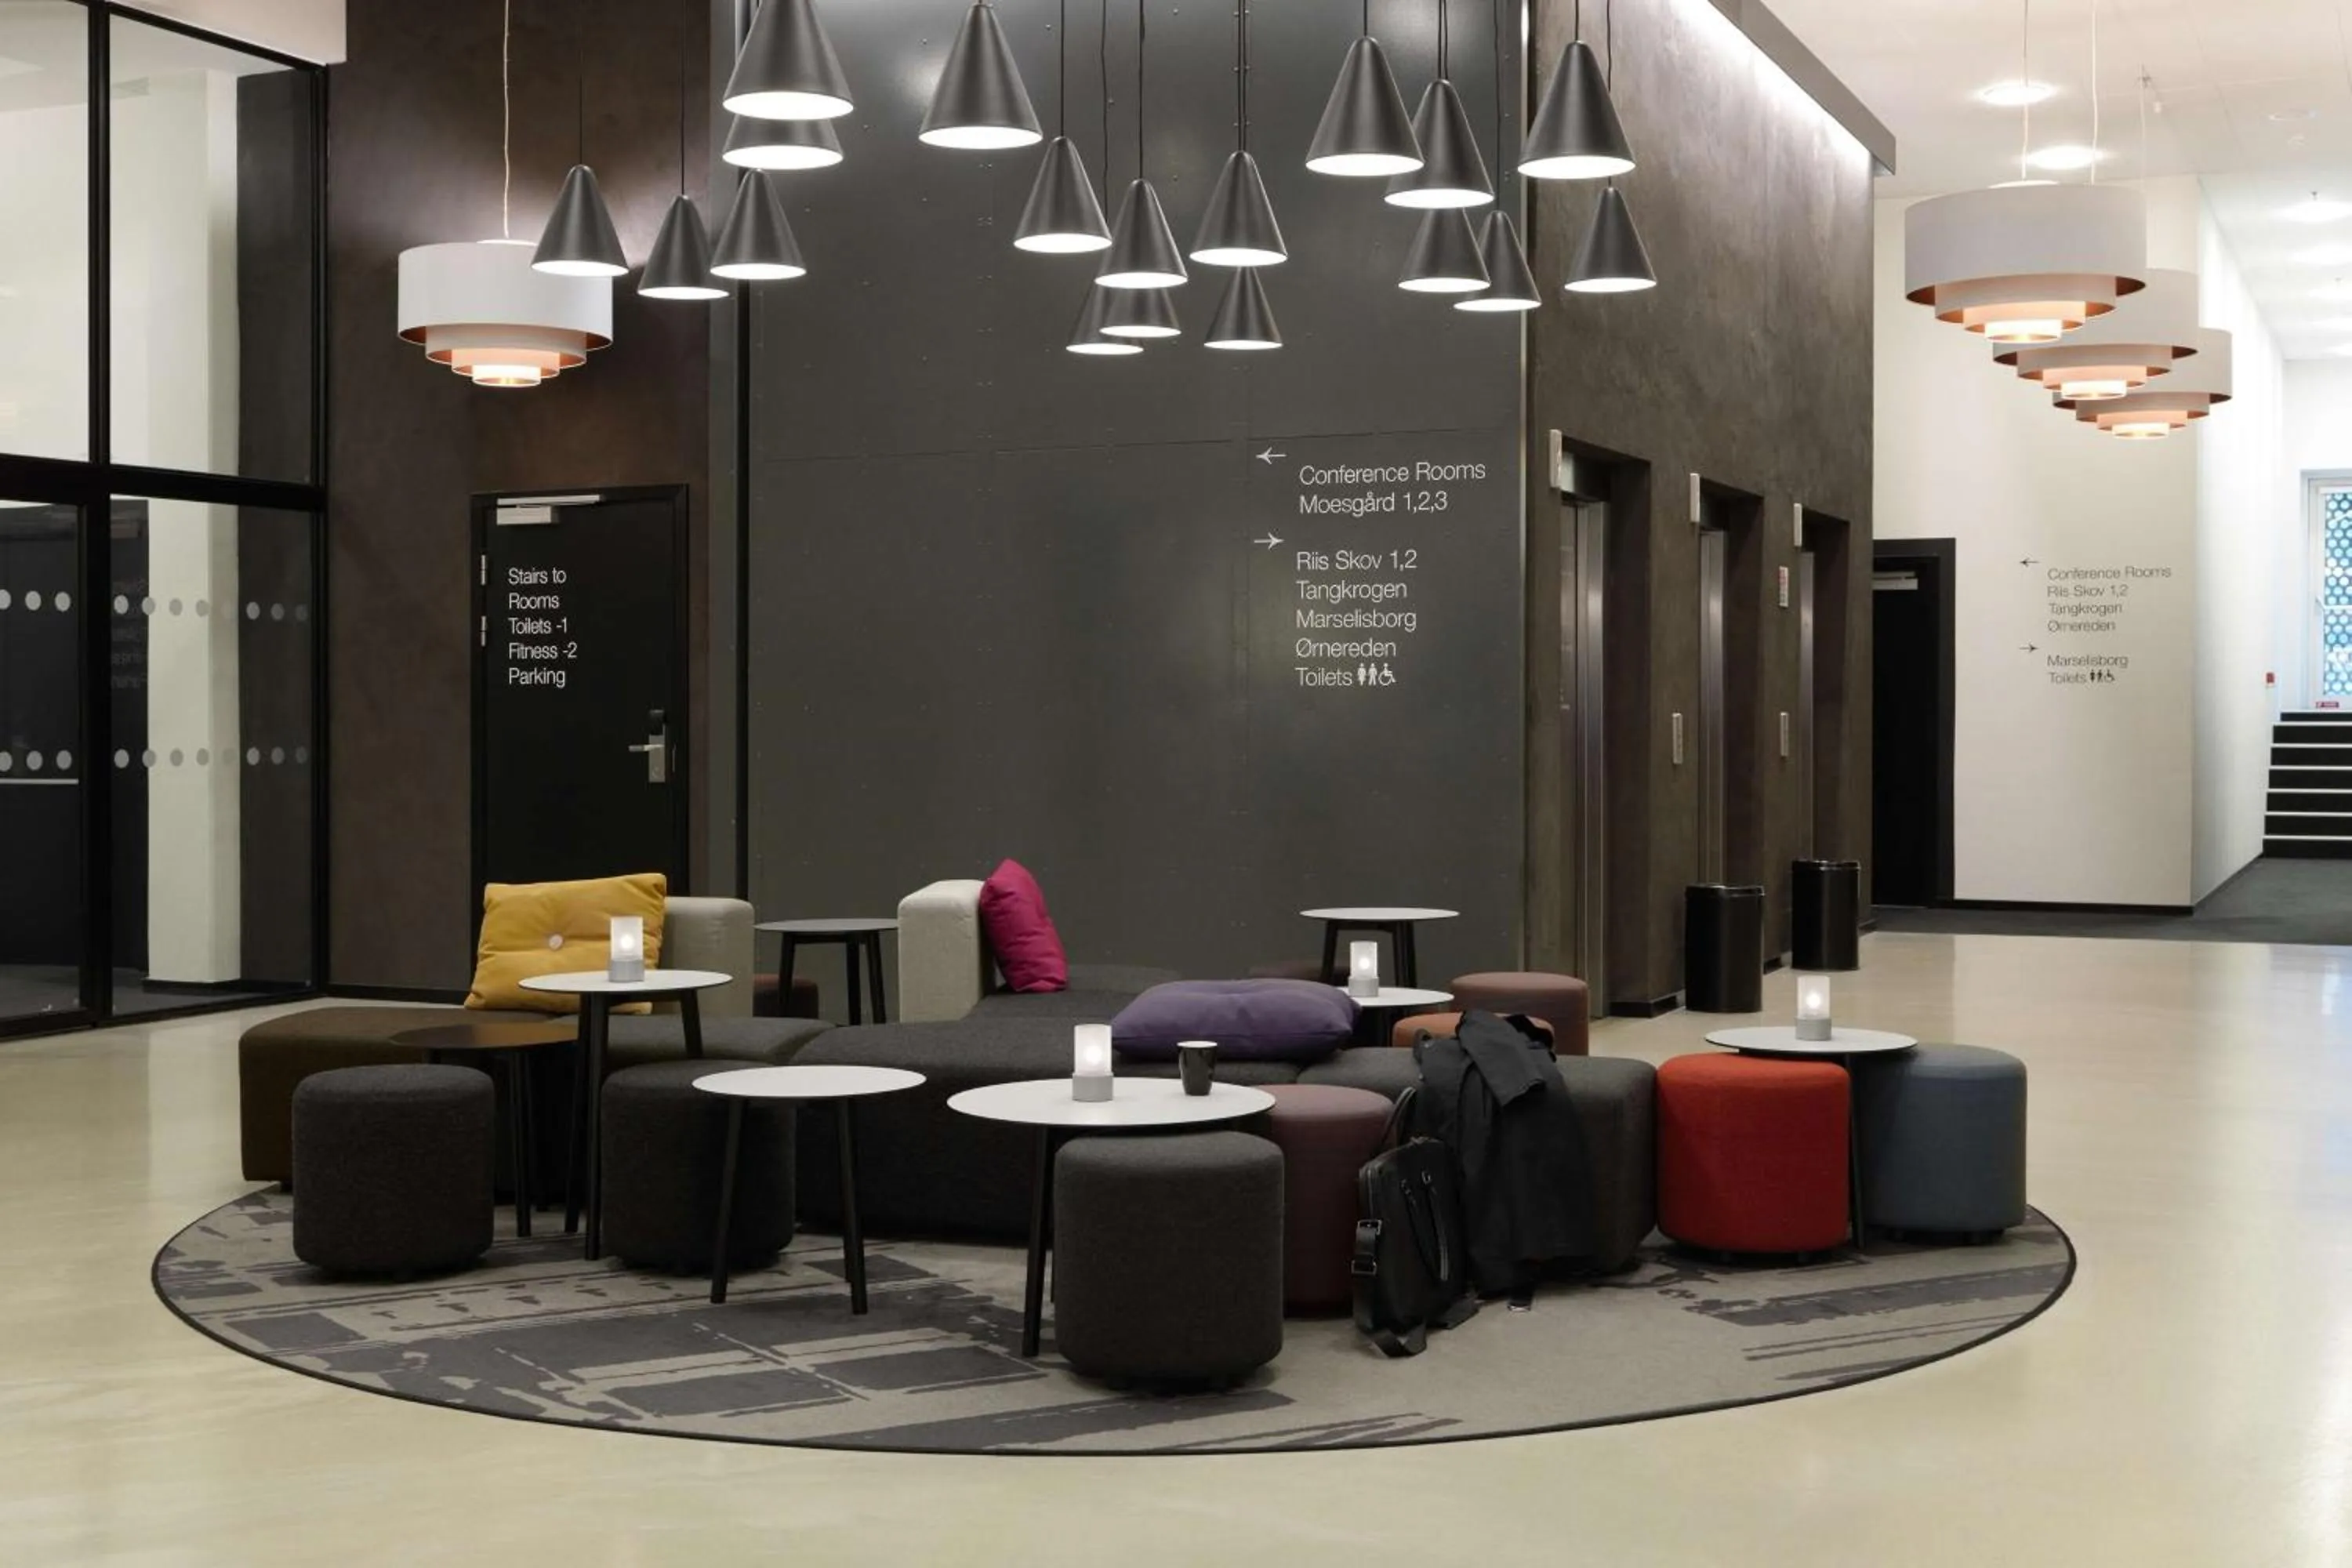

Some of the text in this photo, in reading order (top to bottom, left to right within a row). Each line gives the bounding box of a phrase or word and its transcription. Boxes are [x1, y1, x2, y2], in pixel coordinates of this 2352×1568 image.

[1299, 462, 1486, 485] Conference Rooms
[1300, 491, 1448, 517] Moesgård 1,2,3
[1297, 550, 1417, 572] Riis Skov 1,2
[508, 567, 567, 585] Stairs to
[2047, 565, 2172, 580] Conference Rooms
[1296, 580, 1407, 604] Tangkrogen
[2074, 584, 2104, 597] Skov
[509, 593, 559, 609] Rooms
[2049, 603, 2122, 616] Tangkrogen
[508, 617, 567, 634] Toilets -1
[1297, 609, 1417, 632] Marselisborg
[509, 641, 578, 659] Fitness -2
[1295, 637, 1396, 658] Ørnereden
[509, 667, 565, 688] Parking
[1294, 666, 1352, 687] Toilets
[2049, 671, 2086, 684] Toilets
